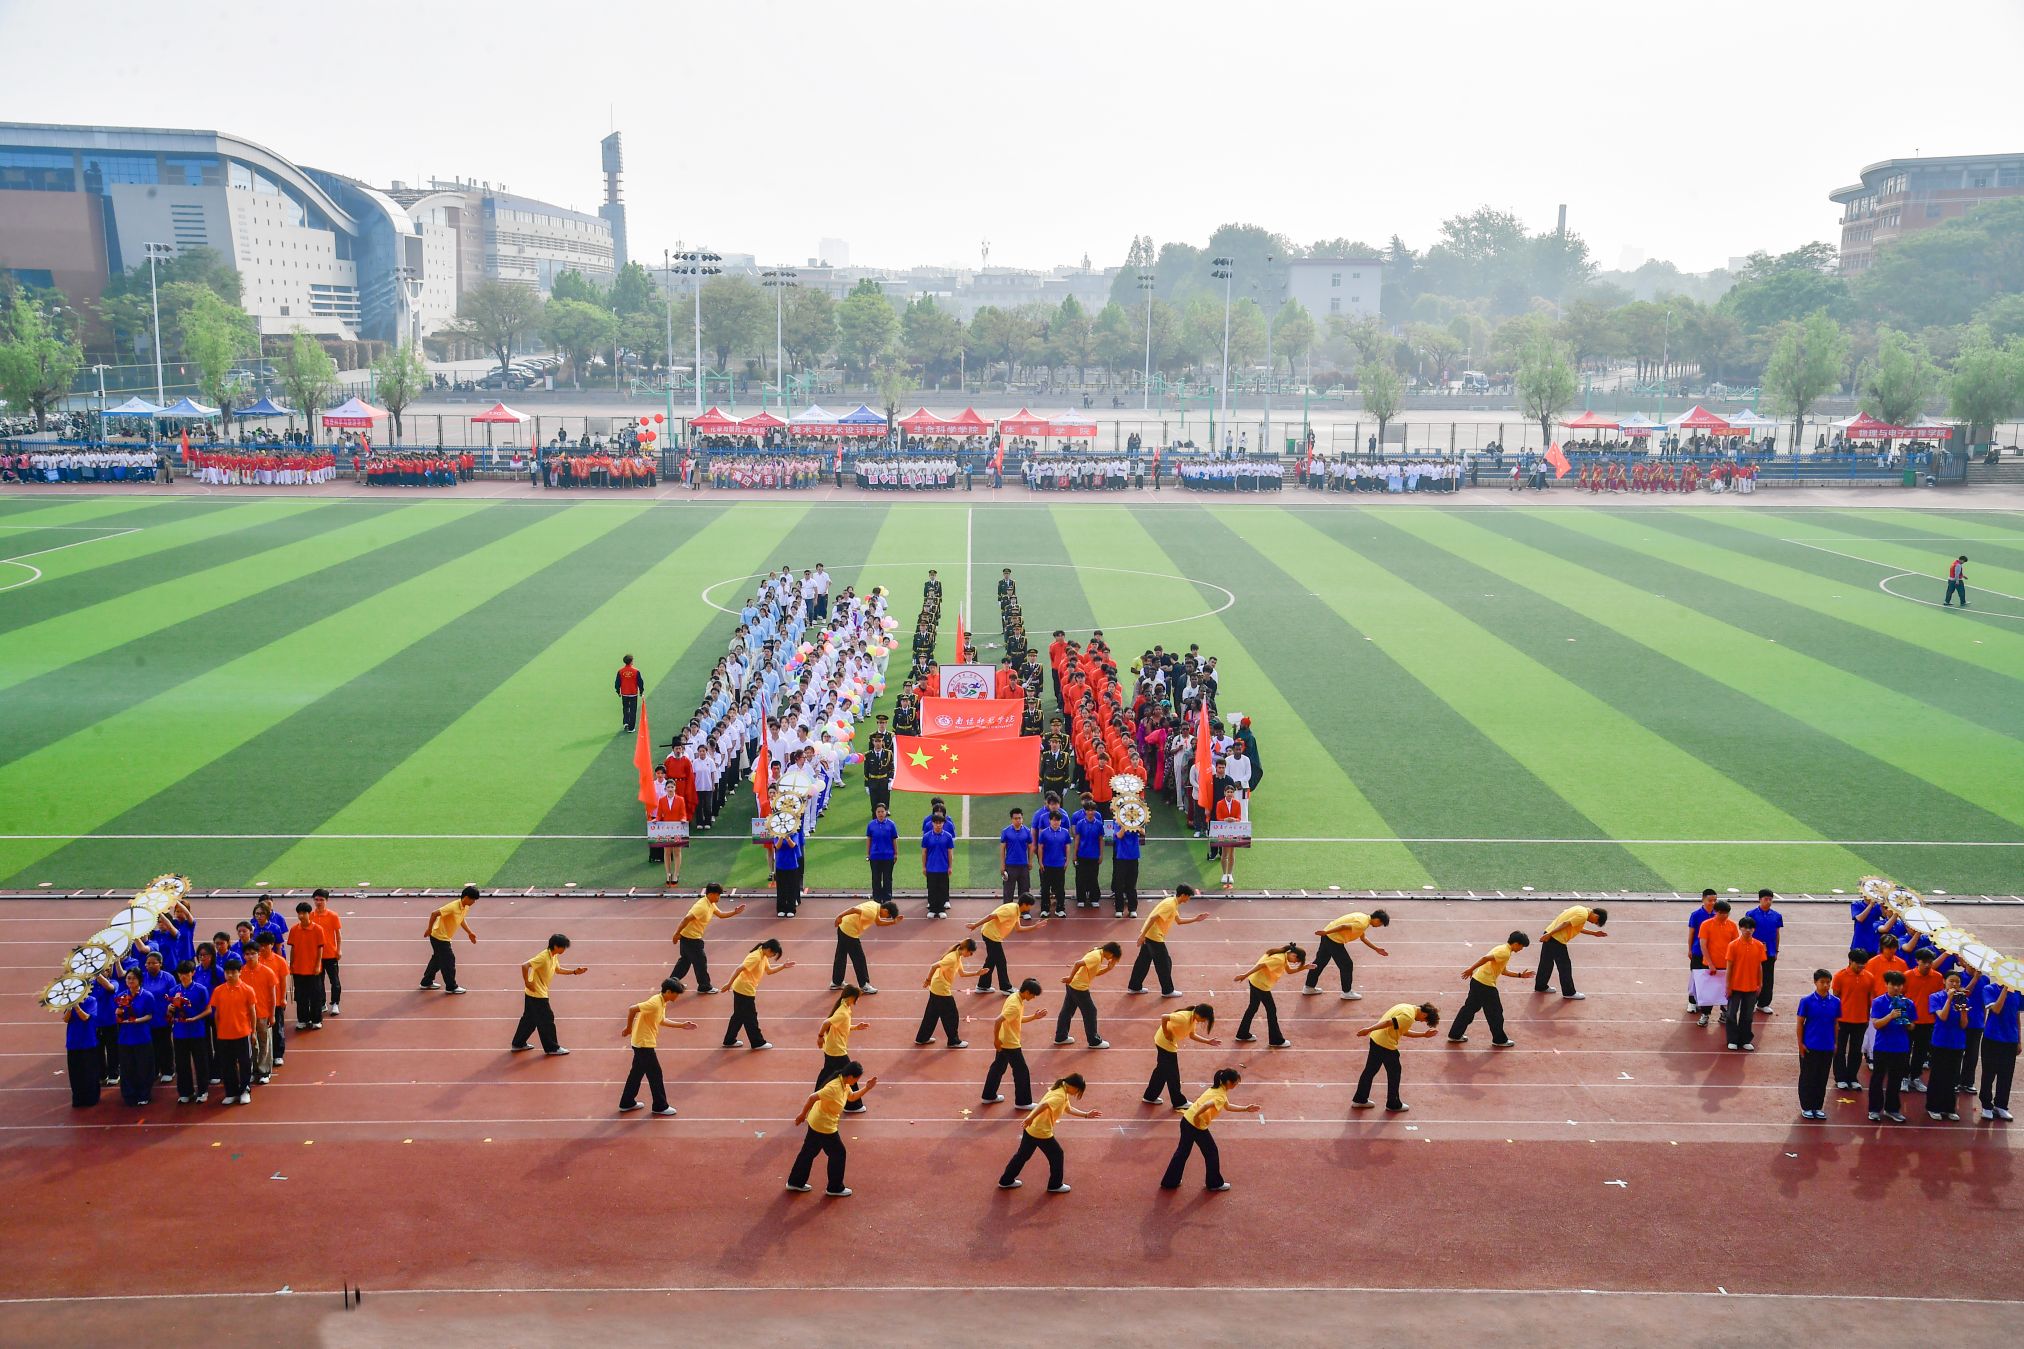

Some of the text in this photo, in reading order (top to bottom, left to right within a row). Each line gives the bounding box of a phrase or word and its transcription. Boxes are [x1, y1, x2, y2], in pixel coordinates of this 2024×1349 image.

[792, 425, 887, 435] 美术与艺术设计学院
[913, 425, 979, 434] 生命科学学院
[1858, 429, 1946, 438] 物理与电子工程学院
